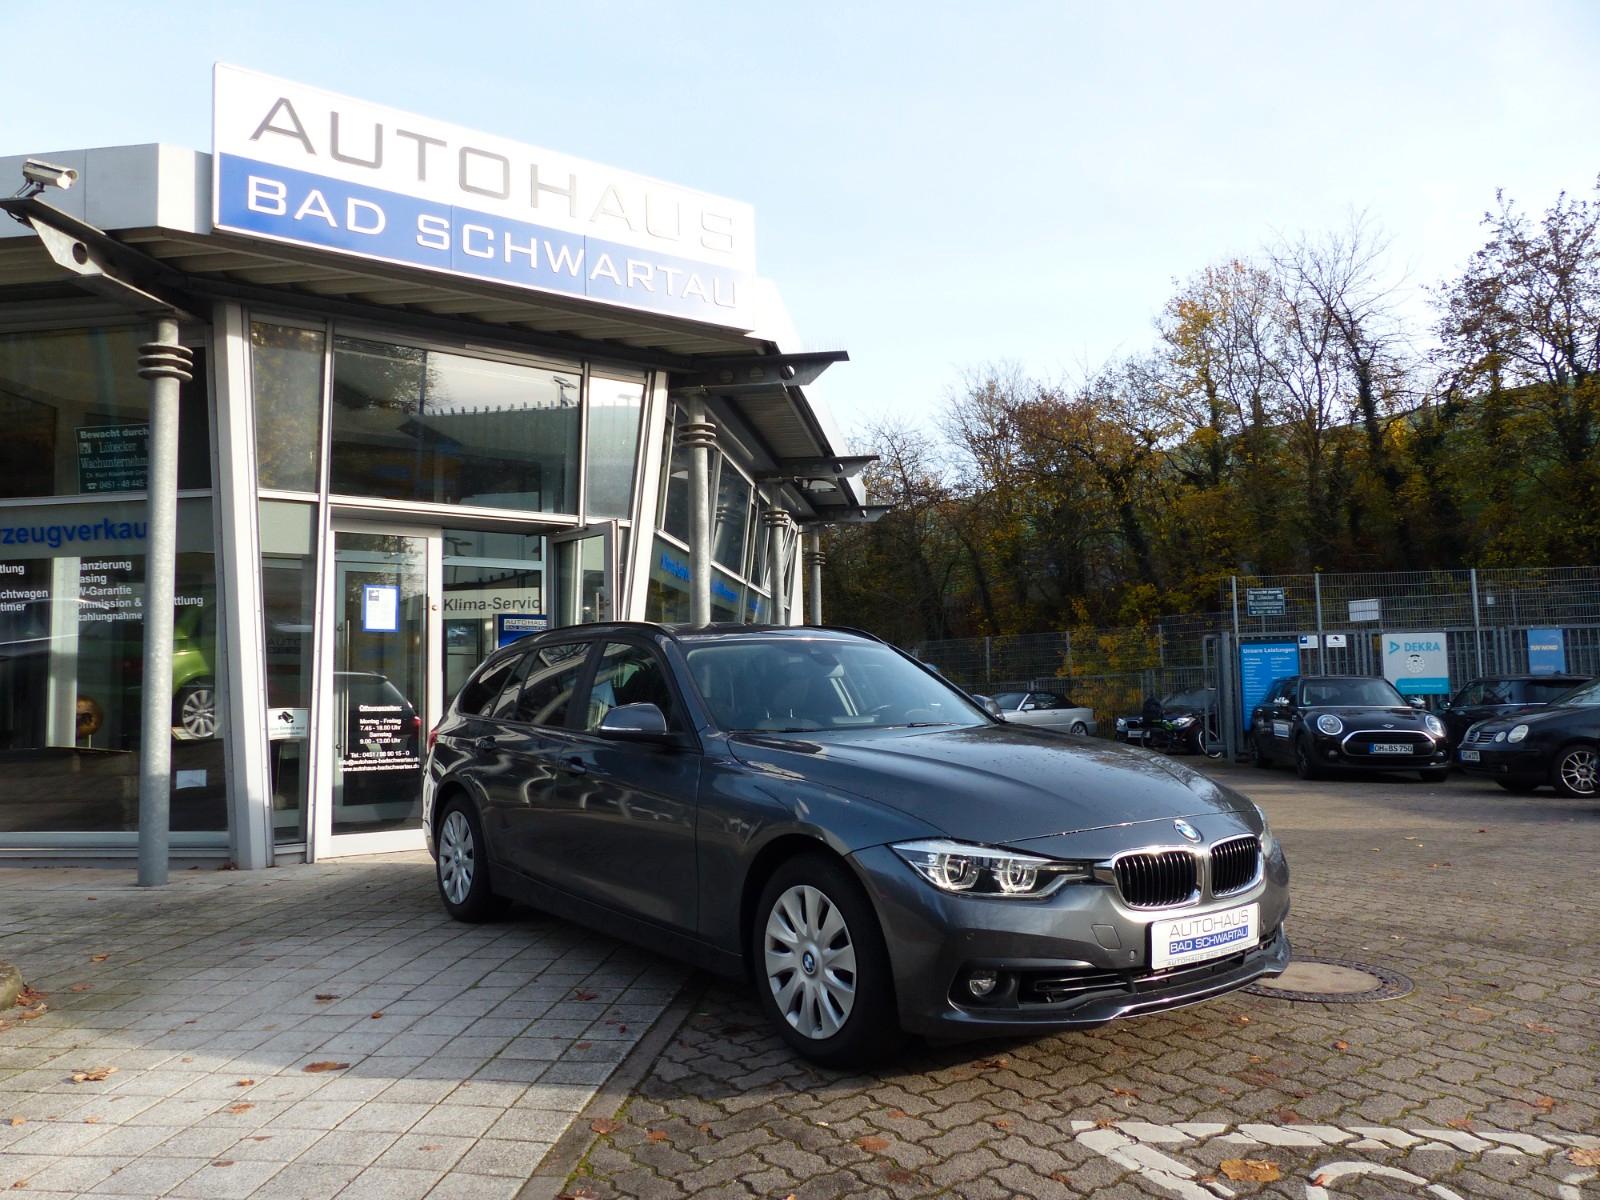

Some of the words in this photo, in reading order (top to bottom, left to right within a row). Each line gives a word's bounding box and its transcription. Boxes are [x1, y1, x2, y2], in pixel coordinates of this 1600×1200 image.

[248, 96, 733, 255] AUTOHAUS
[247, 175, 387, 236] BAD
[416, 213, 737, 309] SCHWARTAU
[80, 429, 120, 439] Bewacht
[122, 427, 149, 437] durch
[0, 518, 147, 548] zeugverkau
[0, 565, 25, 575] tlung
[80, 561, 132, 571] anzierung
[80, 574, 107, 584] asing
[0, 590, 48, 600] chtwagen
[0, 602, 26, 612] timer
[79, 598, 132, 608] ommission
[134, 598, 142, 607] &
[174, 596, 203, 607] ttlung
[443, 596, 540, 612] Klima-Servic
[79, 611, 143, 622] zahlungnahme
[1404, 642, 1441, 652] DEKRA
[1169, 909, 1248, 938] AUTOHAUS
[1170, 941, 1193, 954] BAD
[1195, 927, 1248, 948] SCHWARTAU
